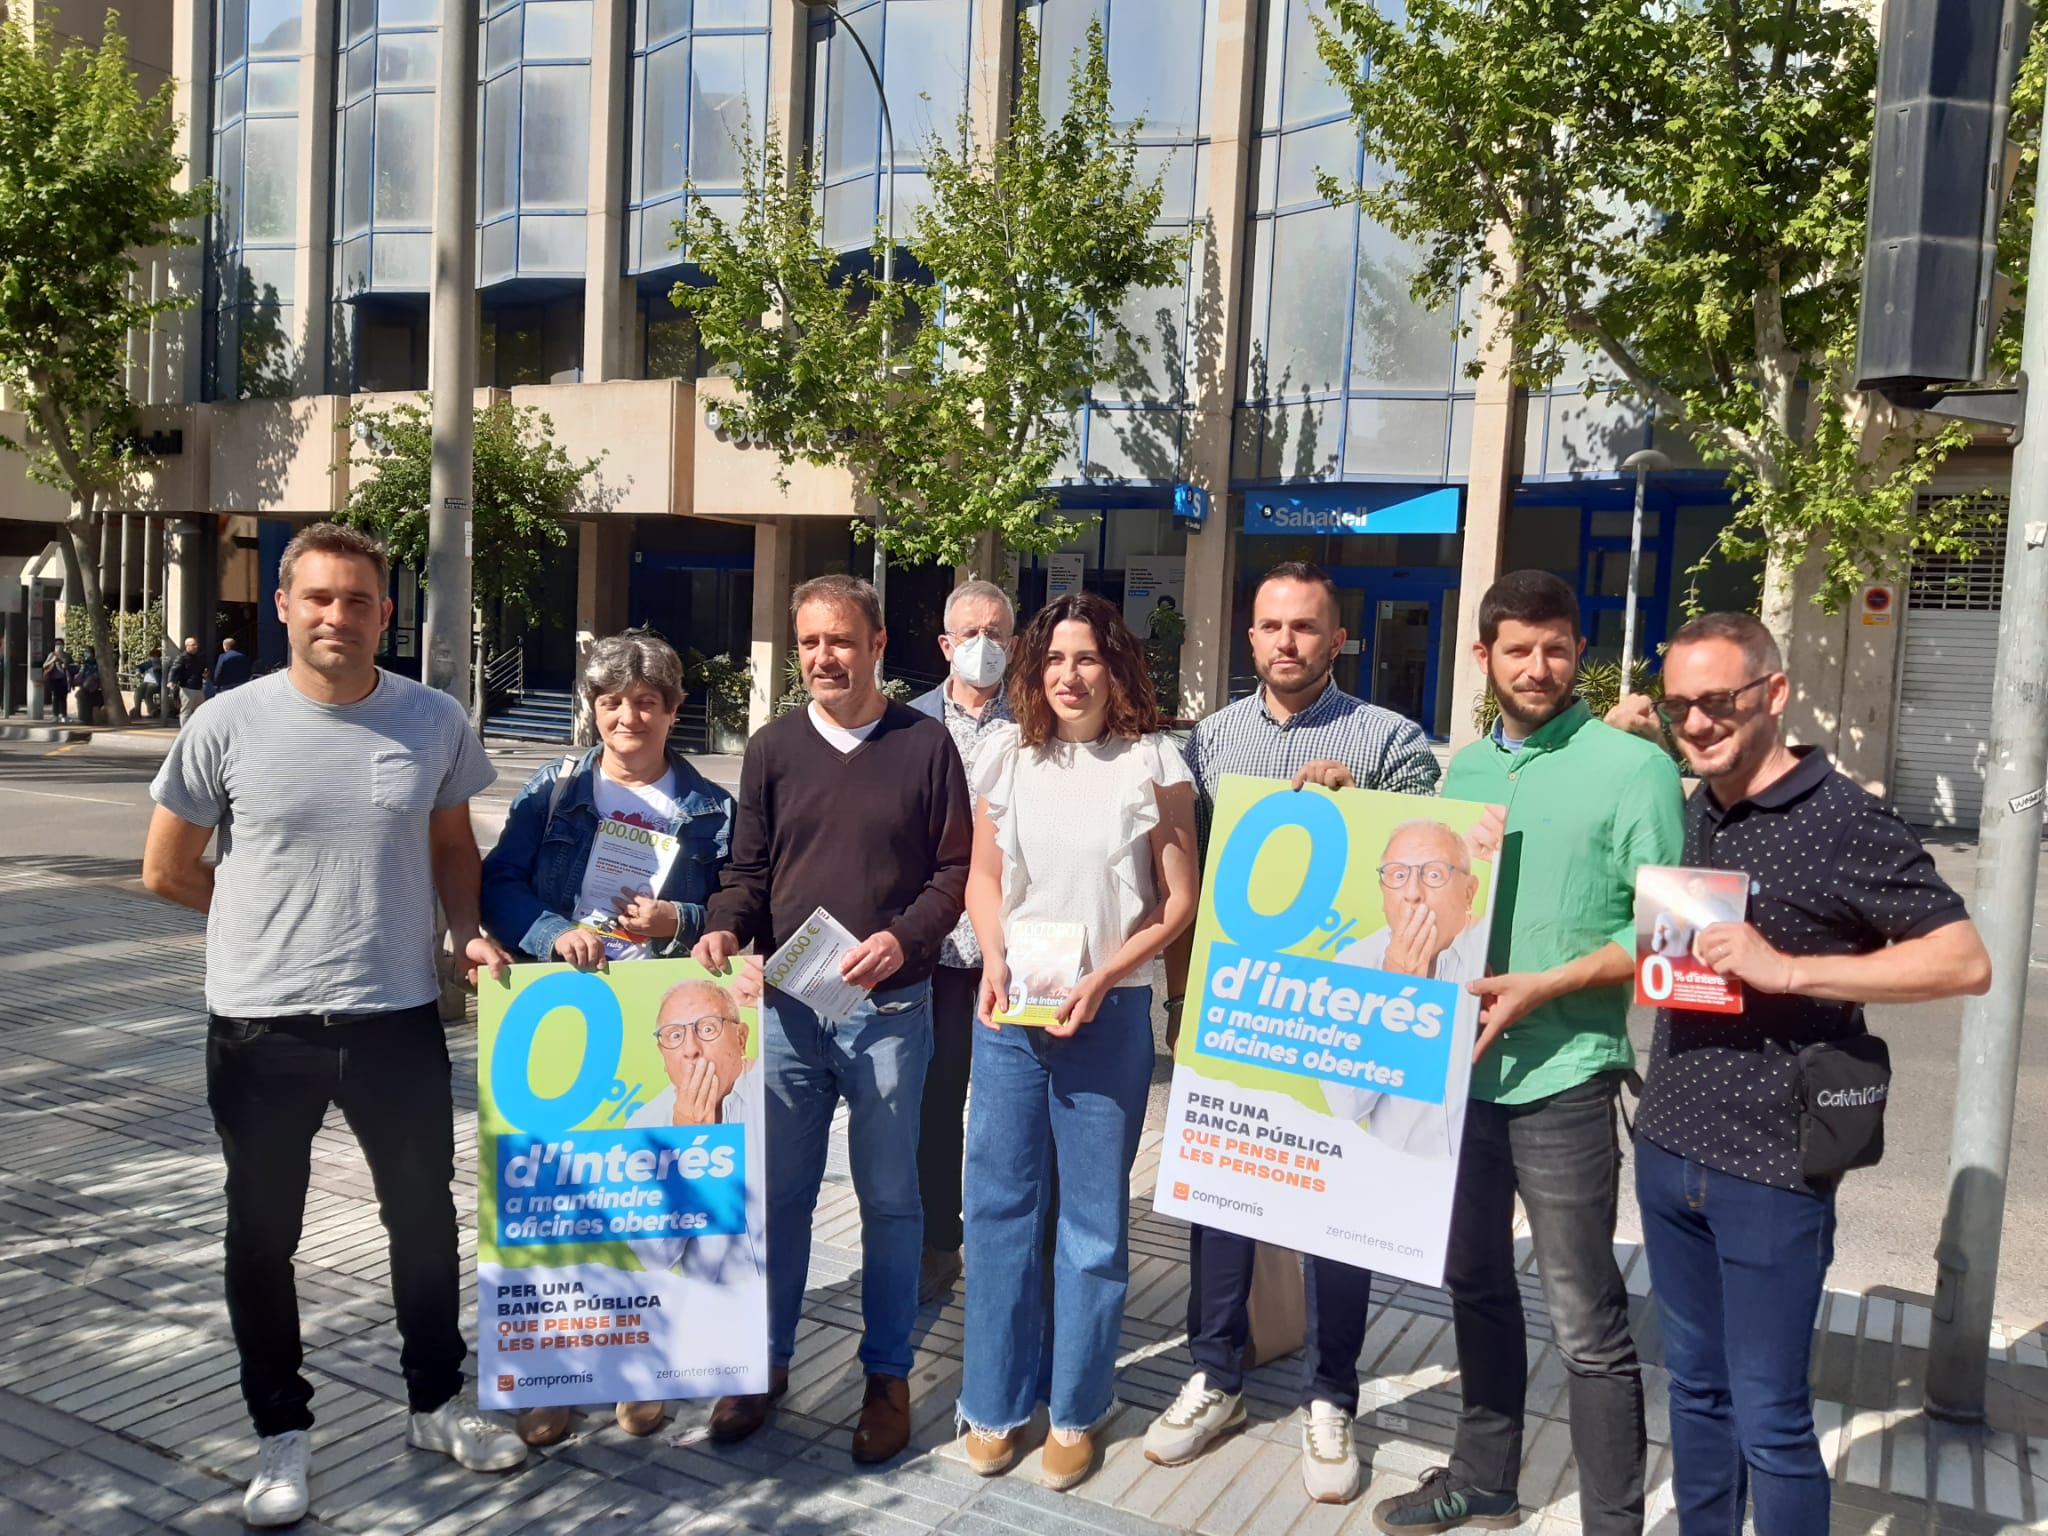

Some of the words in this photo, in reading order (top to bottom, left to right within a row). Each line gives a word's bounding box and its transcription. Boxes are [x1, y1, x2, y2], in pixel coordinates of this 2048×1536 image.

[1274, 506, 1368, 527] Sabadell
[1211, 956, 1445, 1039] d'interés
[1207, 1005, 1226, 1024] a
[1227, 1009, 1362, 1051] mantindre
[1203, 1028, 1299, 1066] oficines
[1302, 1048, 1405, 1088] obertes
[1187, 1092, 1225, 1111] PER
[1229, 1101, 1270, 1122] UNA
[1816, 1088, 1863, 1107] Calvin
[1184, 1109, 1250, 1137] BANCA
[1255, 1126, 1343, 1159] PÚBLICA
[503, 1134, 736, 1188] d'interés
[1182, 1128, 1221, 1148] QUE
[1225, 1138, 1290, 1165] PENSE
[1294, 1154, 1321, 1173] EN
[1179, 1146, 1215, 1165] LES
[1218, 1155, 1327, 1193] PERSONES
[505, 1197, 523, 1214] a
[528, 1185, 663, 1213] mantindre
[1191, 1189, 1264, 1217] compromís
[504, 1214, 604, 1239] oficines
[609, 1211, 708, 1234] obertes
[1325, 1225, 1424, 1259] zerointeres.com
[497, 1284, 537, 1299] PER
[542, 1281, 585, 1296] UNA
[497, 1300, 568, 1317] BANCA
[573, 1294, 662, 1313] PÚBLICA
[497, 1319, 539, 1337] QUE
[544, 1316, 610, 1332] PENSE
[615, 1314, 641, 1328] EN
[497, 1337, 535, 1352] LES
[540, 1331, 650, 1350] PERSONES
[517, 1370, 593, 1389] compromís
[655, 1364, 749, 1380] zerointeres.com
